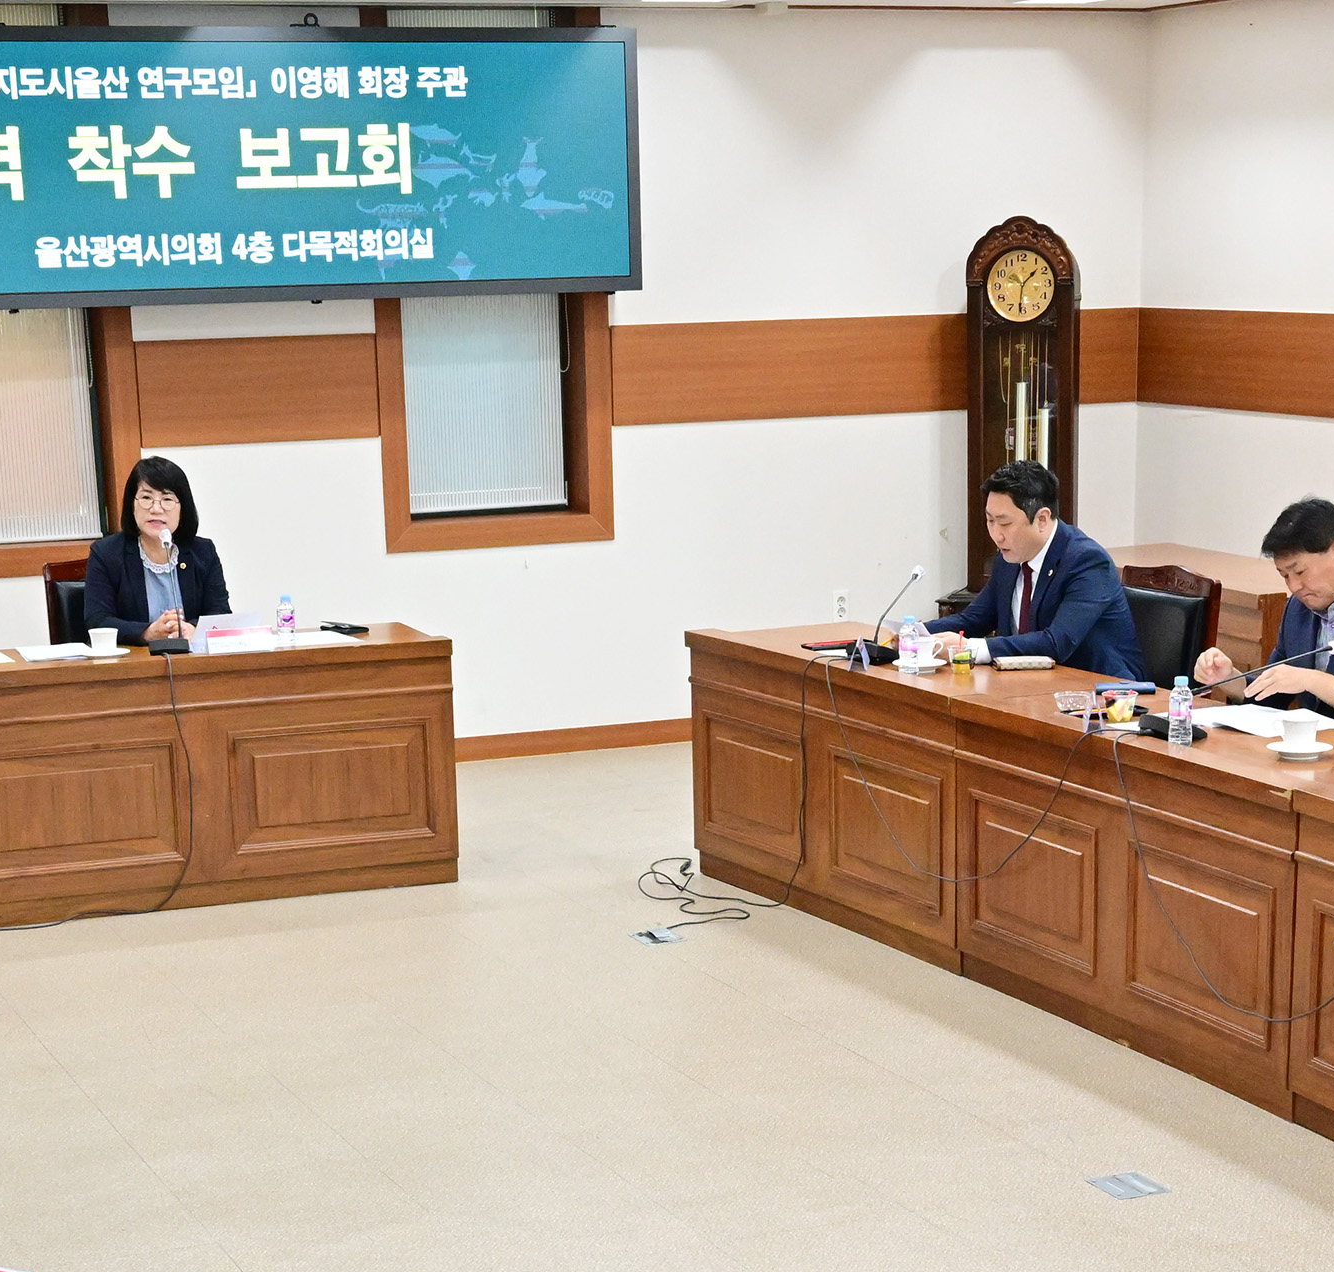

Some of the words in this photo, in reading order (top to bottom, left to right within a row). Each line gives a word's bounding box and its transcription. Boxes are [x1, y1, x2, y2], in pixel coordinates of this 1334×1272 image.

[138, 66, 256, 99] 연구모임」
[271, 66, 349, 98] 이영해
[358, 66, 409, 98] 회장
[417, 66, 468, 97] 주관
[68, 125, 195, 199] 착수
[237, 123, 412, 194] 보고회
[35, 233, 222, 268] 울산광역시의회
[232, 231, 274, 263] 4층
[283, 228, 434, 262] 다목적회의실
[1017, 253, 1027, 262] 12
[1034, 257, 1038, 265] 1
[1005, 259, 1013, 267] 11
[997, 269, 1006, 278] 10
[1041, 266, 1048, 275] 2
[994, 282, 1002, 290] 9
[1044, 279, 1052, 287] 3
[997, 294, 1005, 302] 8
[1007, 303, 1014, 311] 7
[1032, 302, 1040, 311] 5
